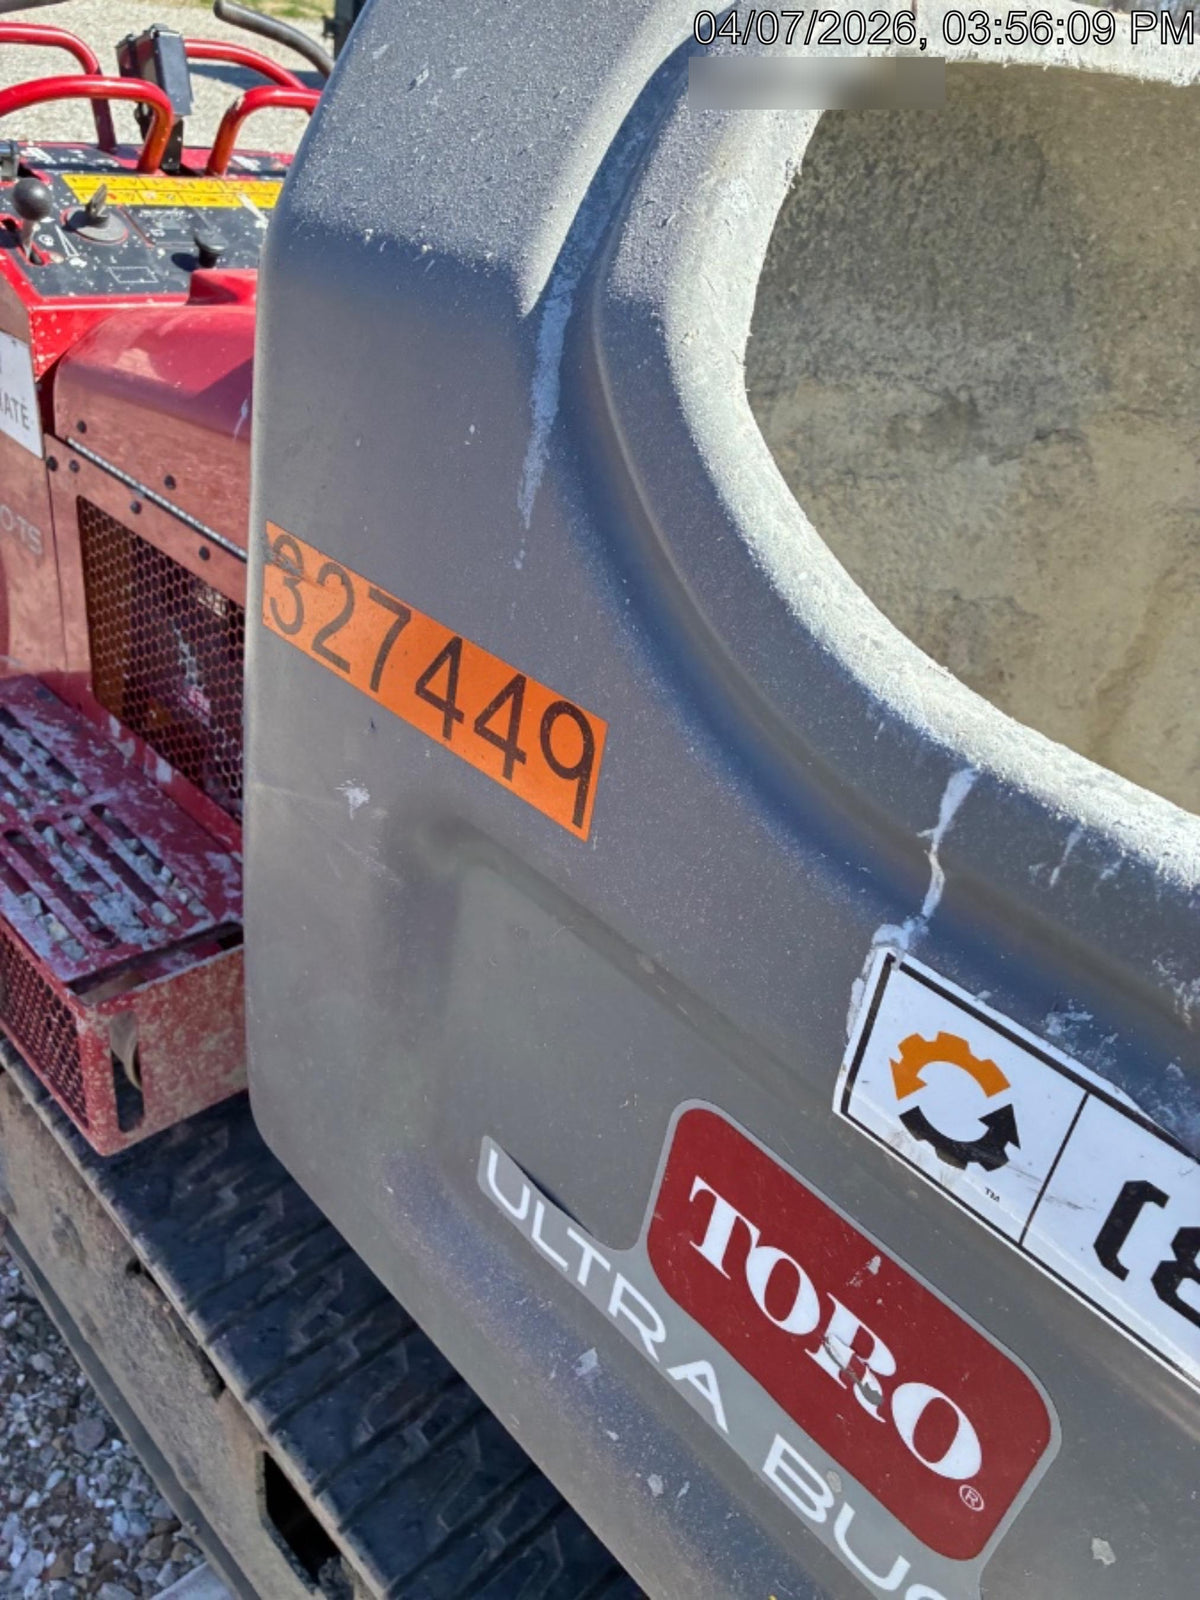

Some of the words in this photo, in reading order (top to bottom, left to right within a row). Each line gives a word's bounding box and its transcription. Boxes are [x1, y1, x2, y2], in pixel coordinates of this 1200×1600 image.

[0, 387, 30, 431] ATE
[269, 533, 596, 830] 327449
[486, 1149, 730, 1435] ULTRA
[689, 1176, 983, 1481] TORO
